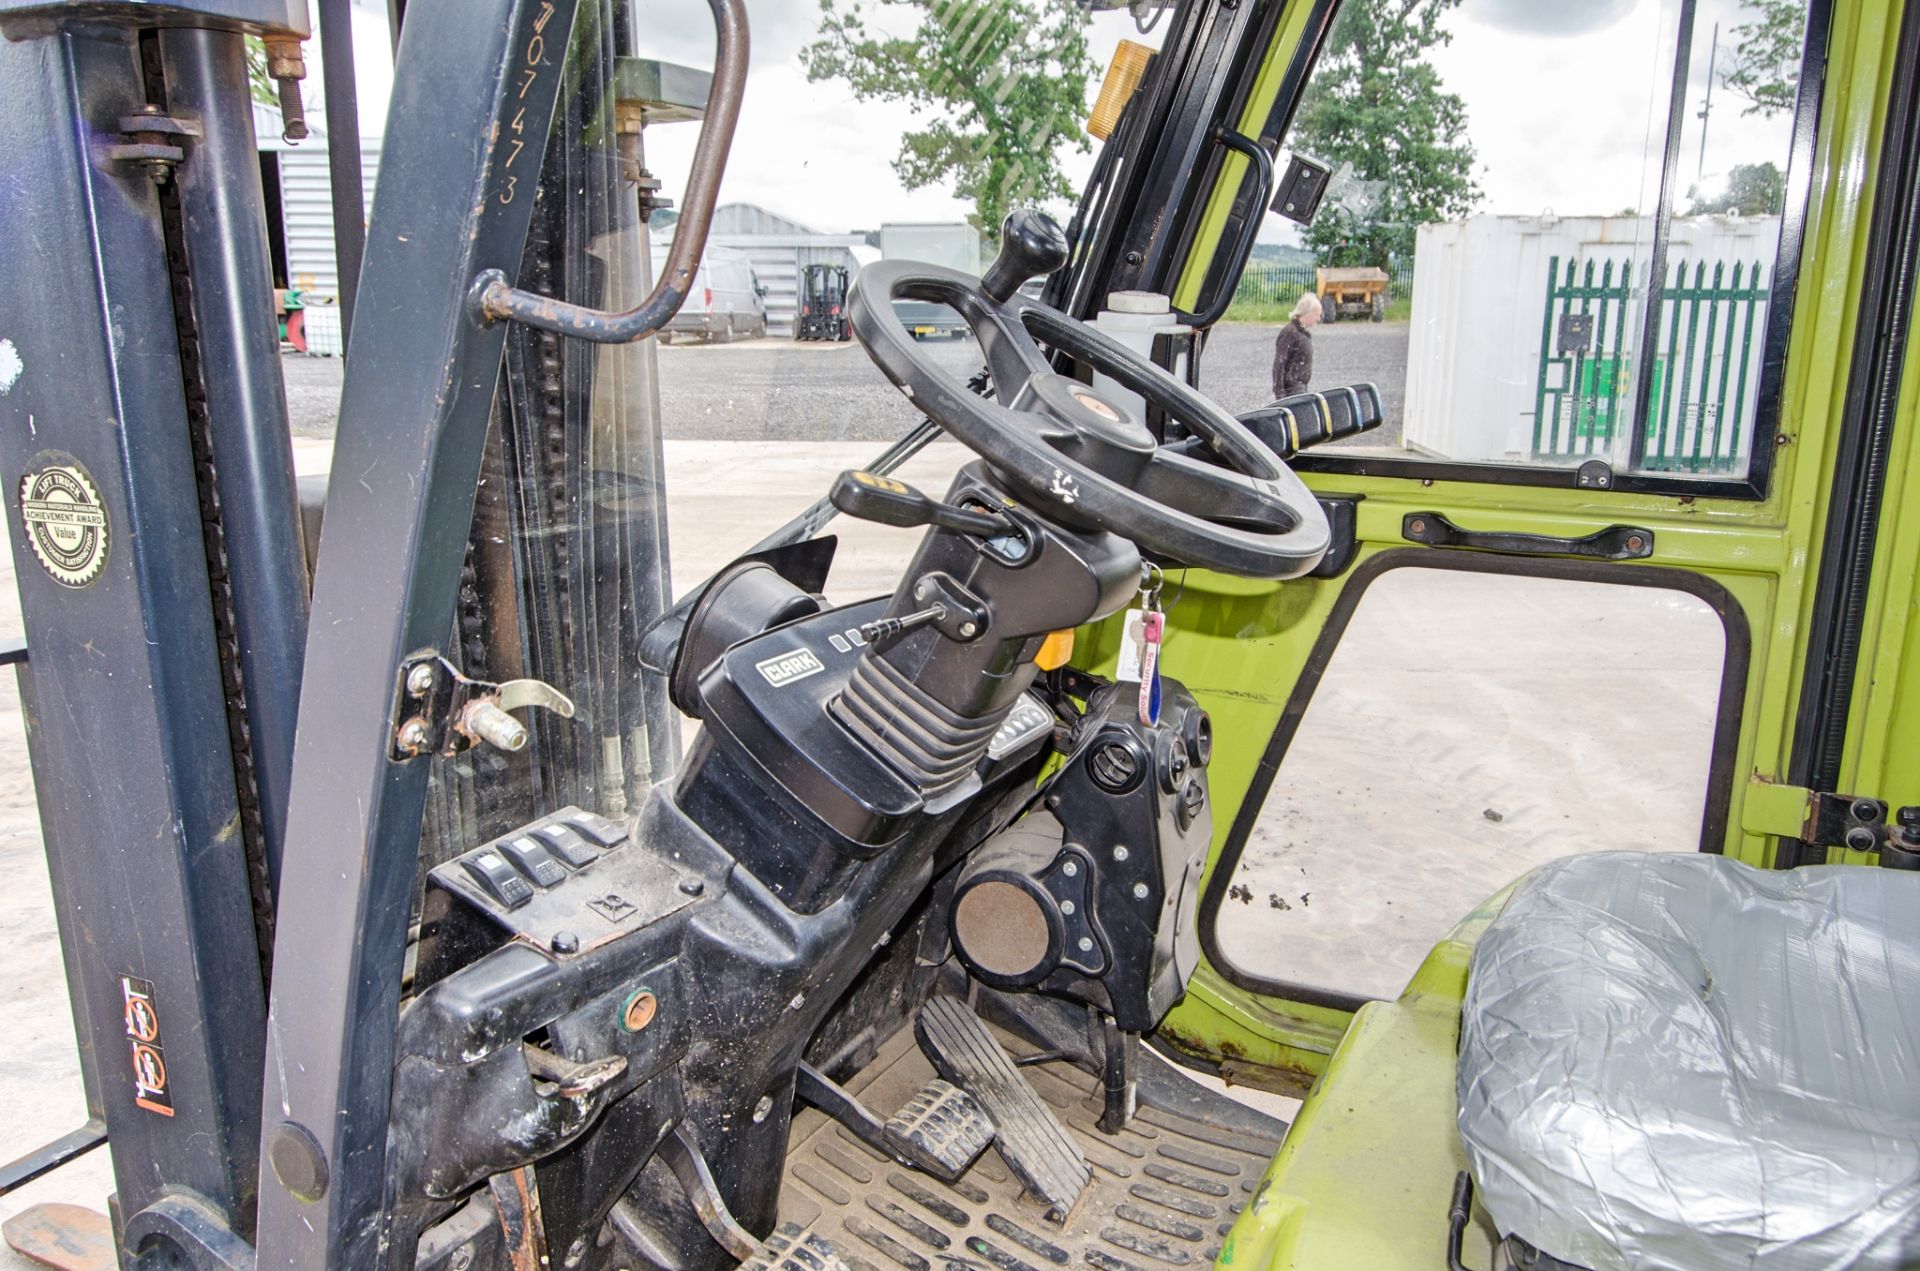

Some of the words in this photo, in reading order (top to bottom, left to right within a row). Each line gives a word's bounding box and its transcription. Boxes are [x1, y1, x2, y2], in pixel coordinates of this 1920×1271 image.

[39, 477, 54, 494] LIFT
[54, 475, 81, 498] TRUCK
[26, 510, 74, 523] ACHIEVEMENT
[76, 514, 102, 525] AWARD
[54, 526, 77, 540] Value
[38, 527, 66, 566] CUSTOMER
[66, 532, 94, 566] SATISFACTION
[763, 653, 817, 681] CLARK
[1140, 651, 1155, 691] Security
